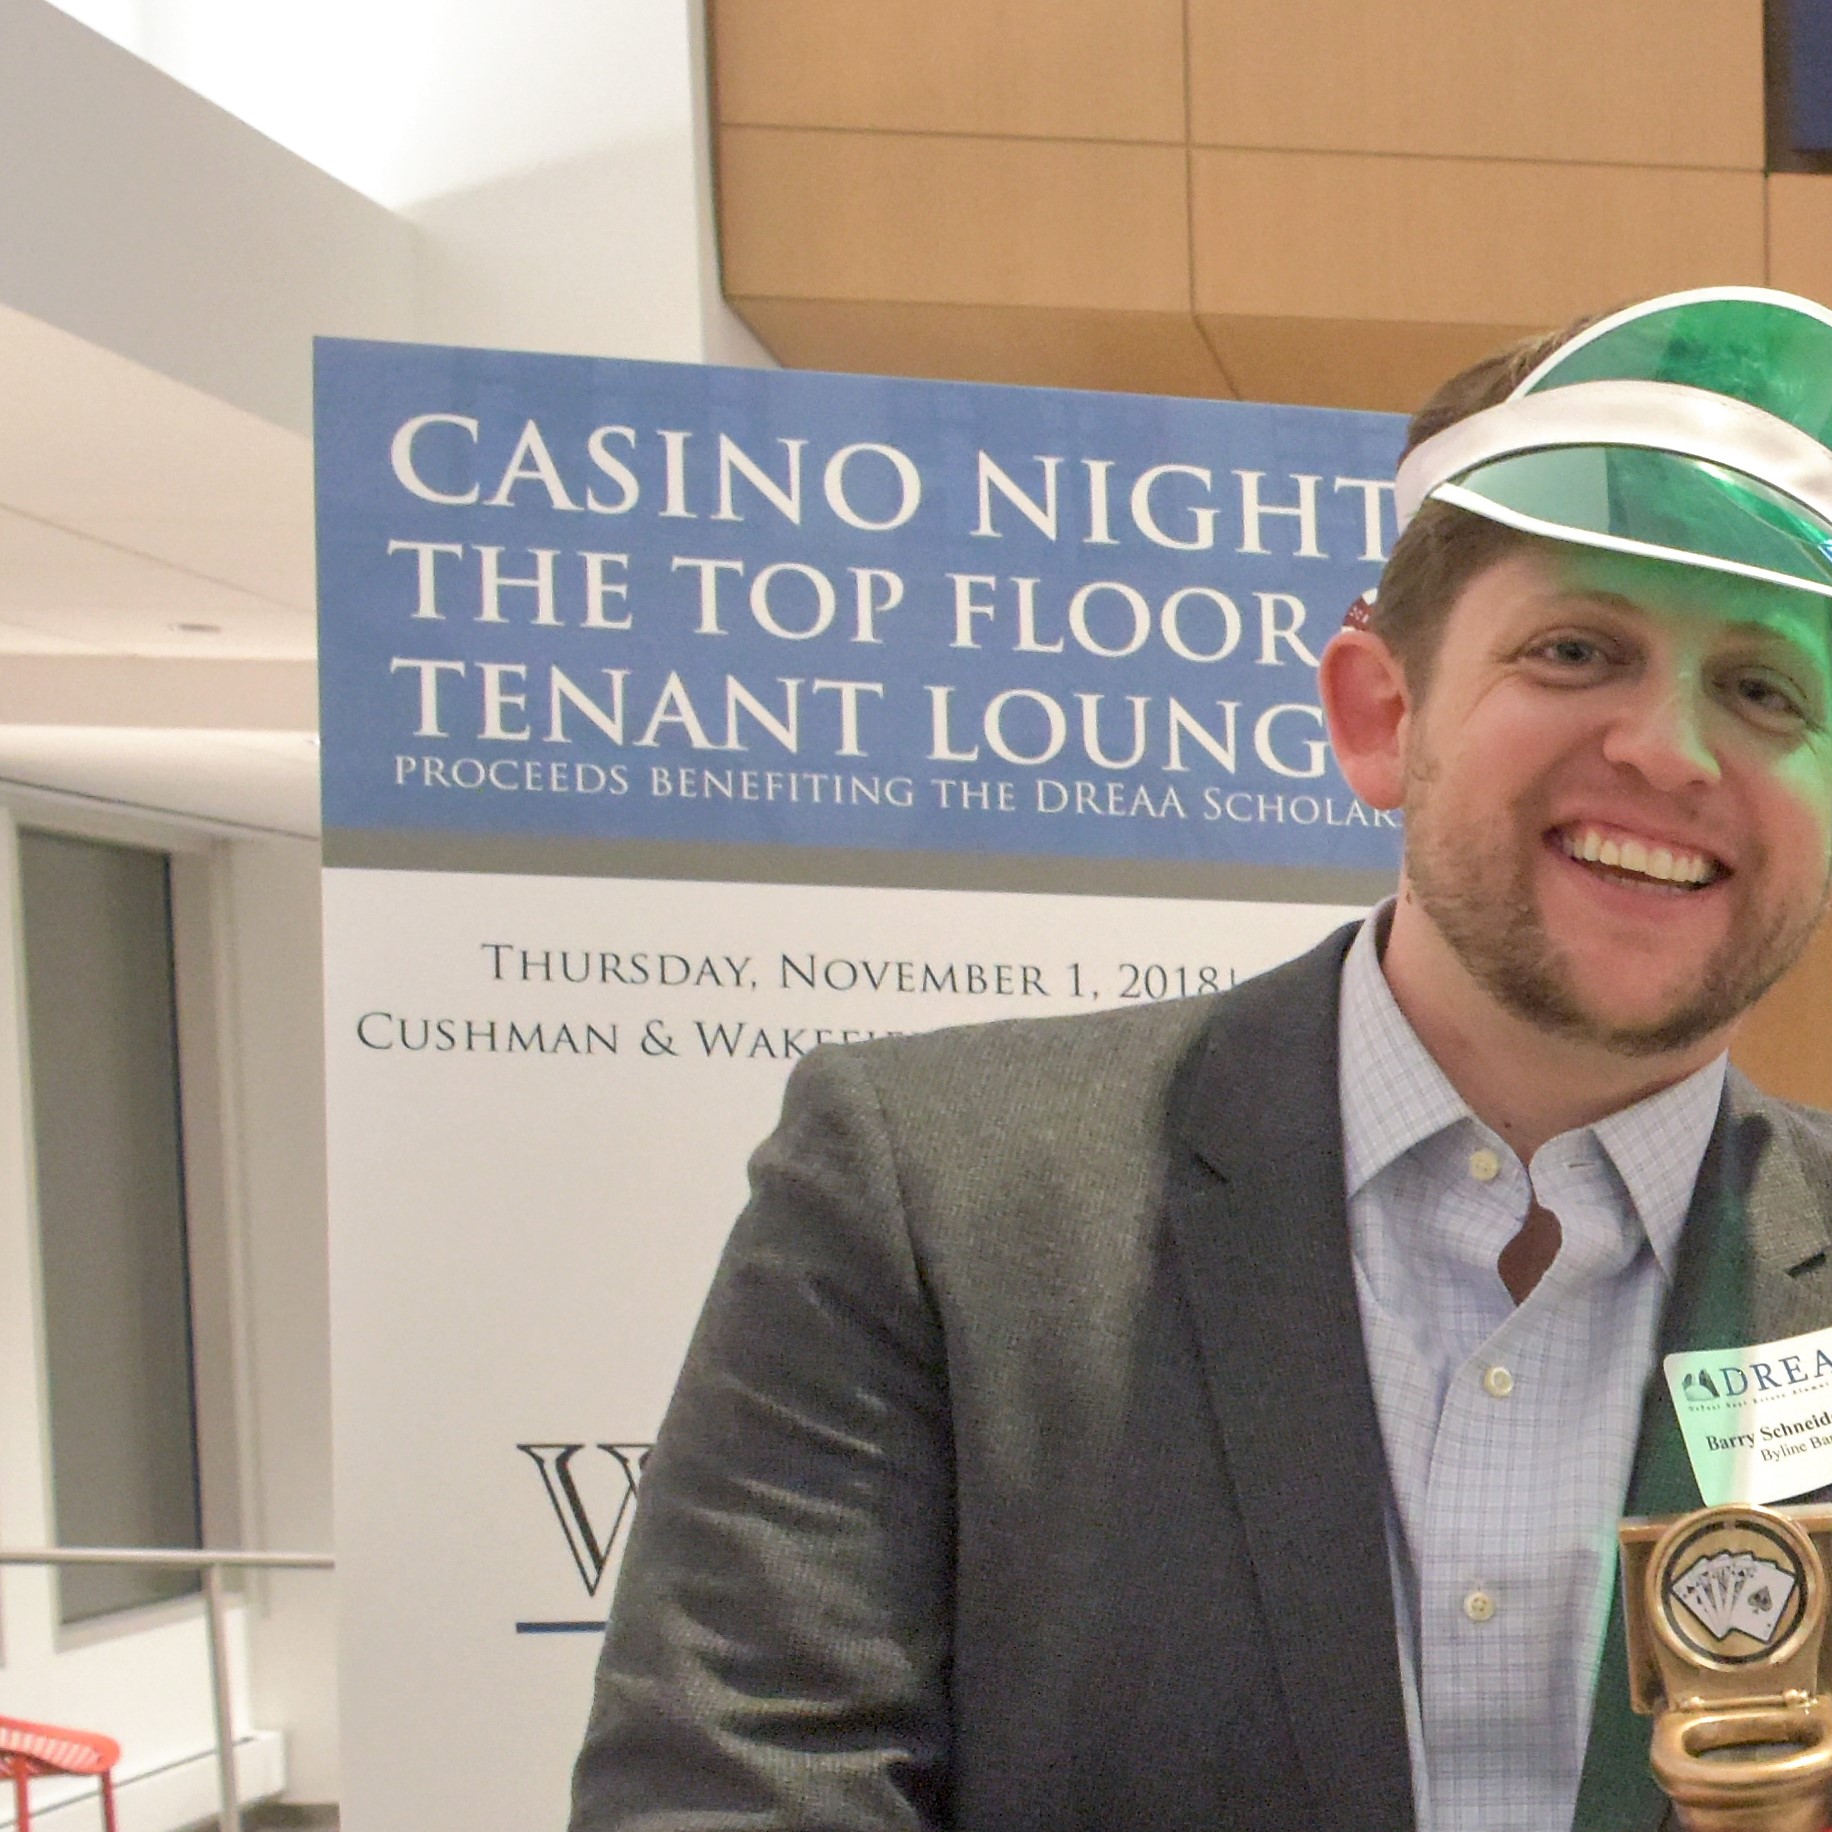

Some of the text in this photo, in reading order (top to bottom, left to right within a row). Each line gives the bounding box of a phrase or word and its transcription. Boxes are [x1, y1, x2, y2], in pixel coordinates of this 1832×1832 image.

[390, 412, 1396, 562] CASINO NIGHT
[387, 539, 1320, 668] THE TOP FLOOR
[390, 656, 883, 757] TENANT
[394, 755, 629, 795] PROCEEDS
[651, 767, 912, 807] BENEFITING
[931, 779, 1016, 811] THE
[1036, 780, 1188, 819] DREAA
[481, 943, 758, 990] THURSDAY,
[779, 952, 1051, 997] NOVEMBER
[1069, 962, 1099, 1000] 1,
[357, 1011, 619, 1055] CUSHMAN
[640, 1018, 679, 1056] &
[1706, 1430, 1755, 1452] Barry
[1761, 1441, 1807, 1462] Byline
